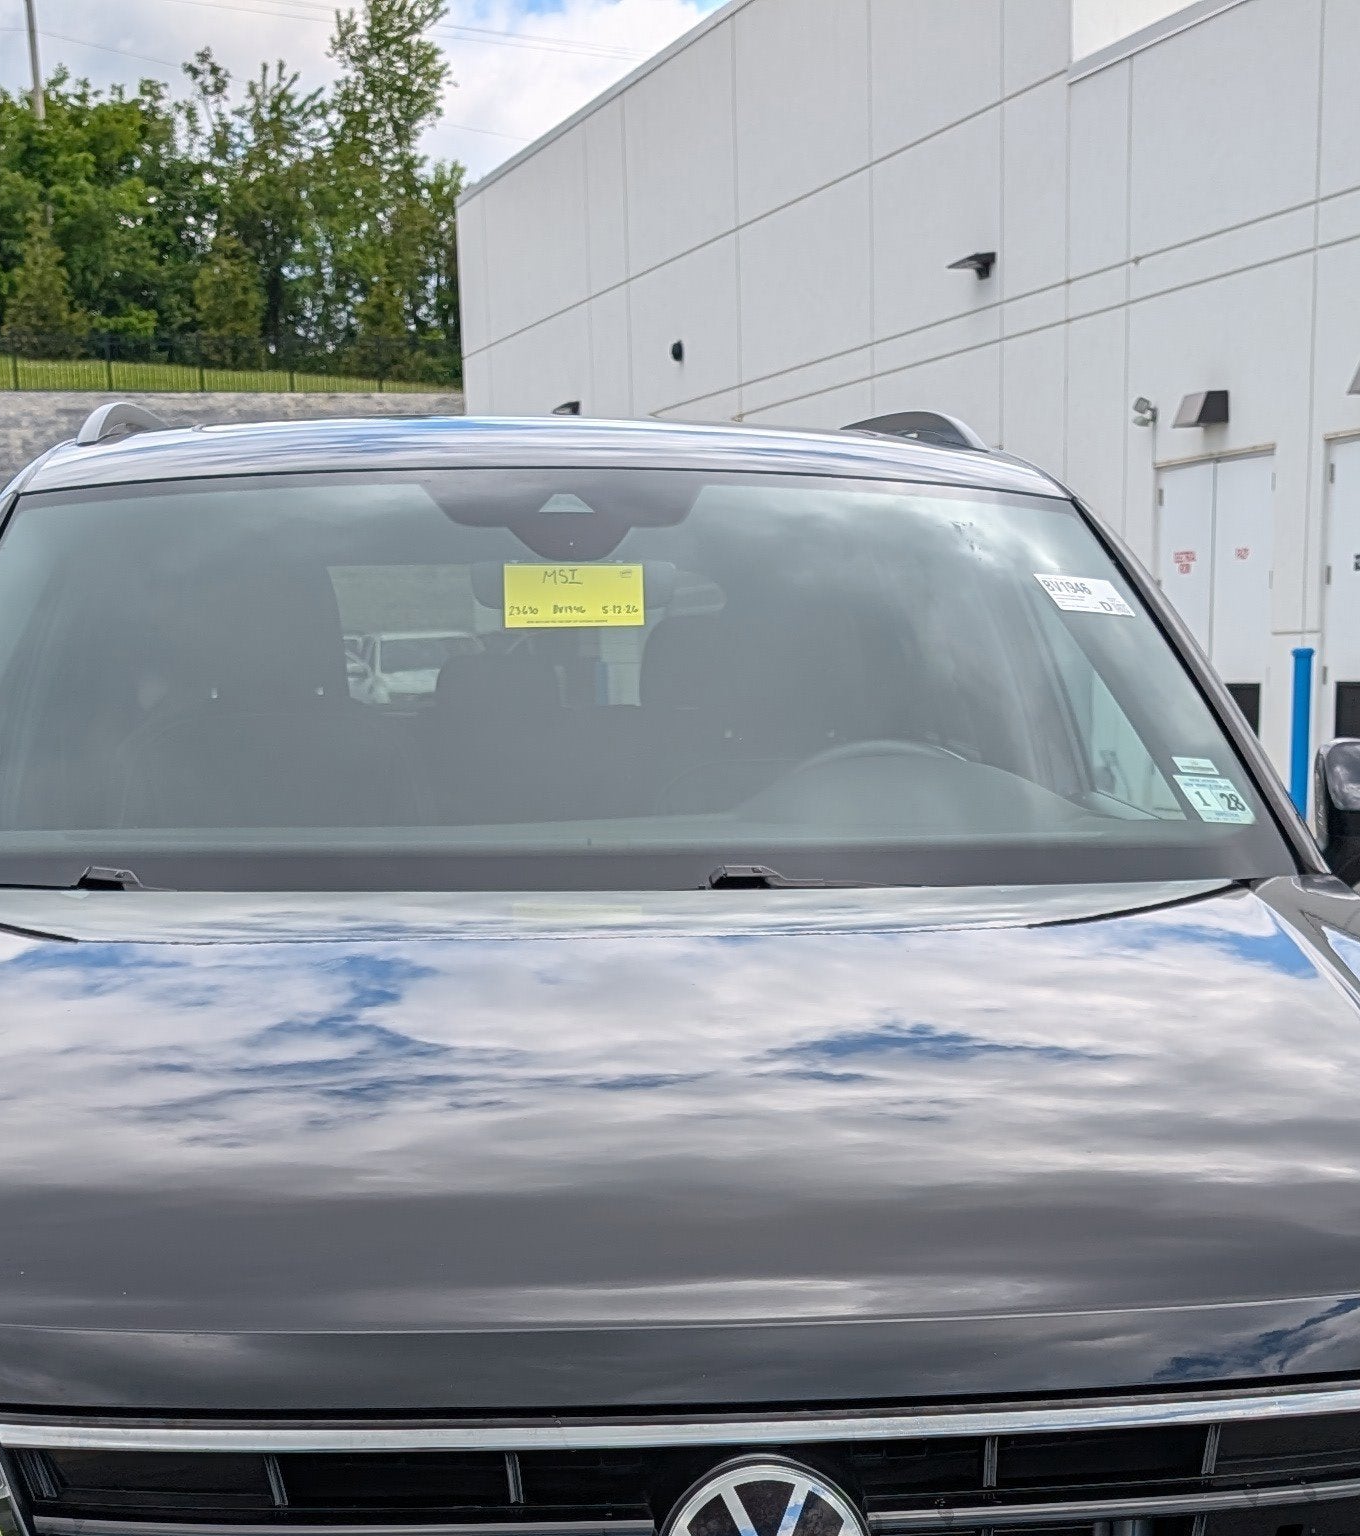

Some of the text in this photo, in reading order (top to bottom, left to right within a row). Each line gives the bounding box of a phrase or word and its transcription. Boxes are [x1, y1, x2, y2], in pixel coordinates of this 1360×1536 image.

[542, 569, 583, 585] MSI
[1042, 579, 1092, 595] BV1946
[1195, 790, 1246, 811] 1 28
